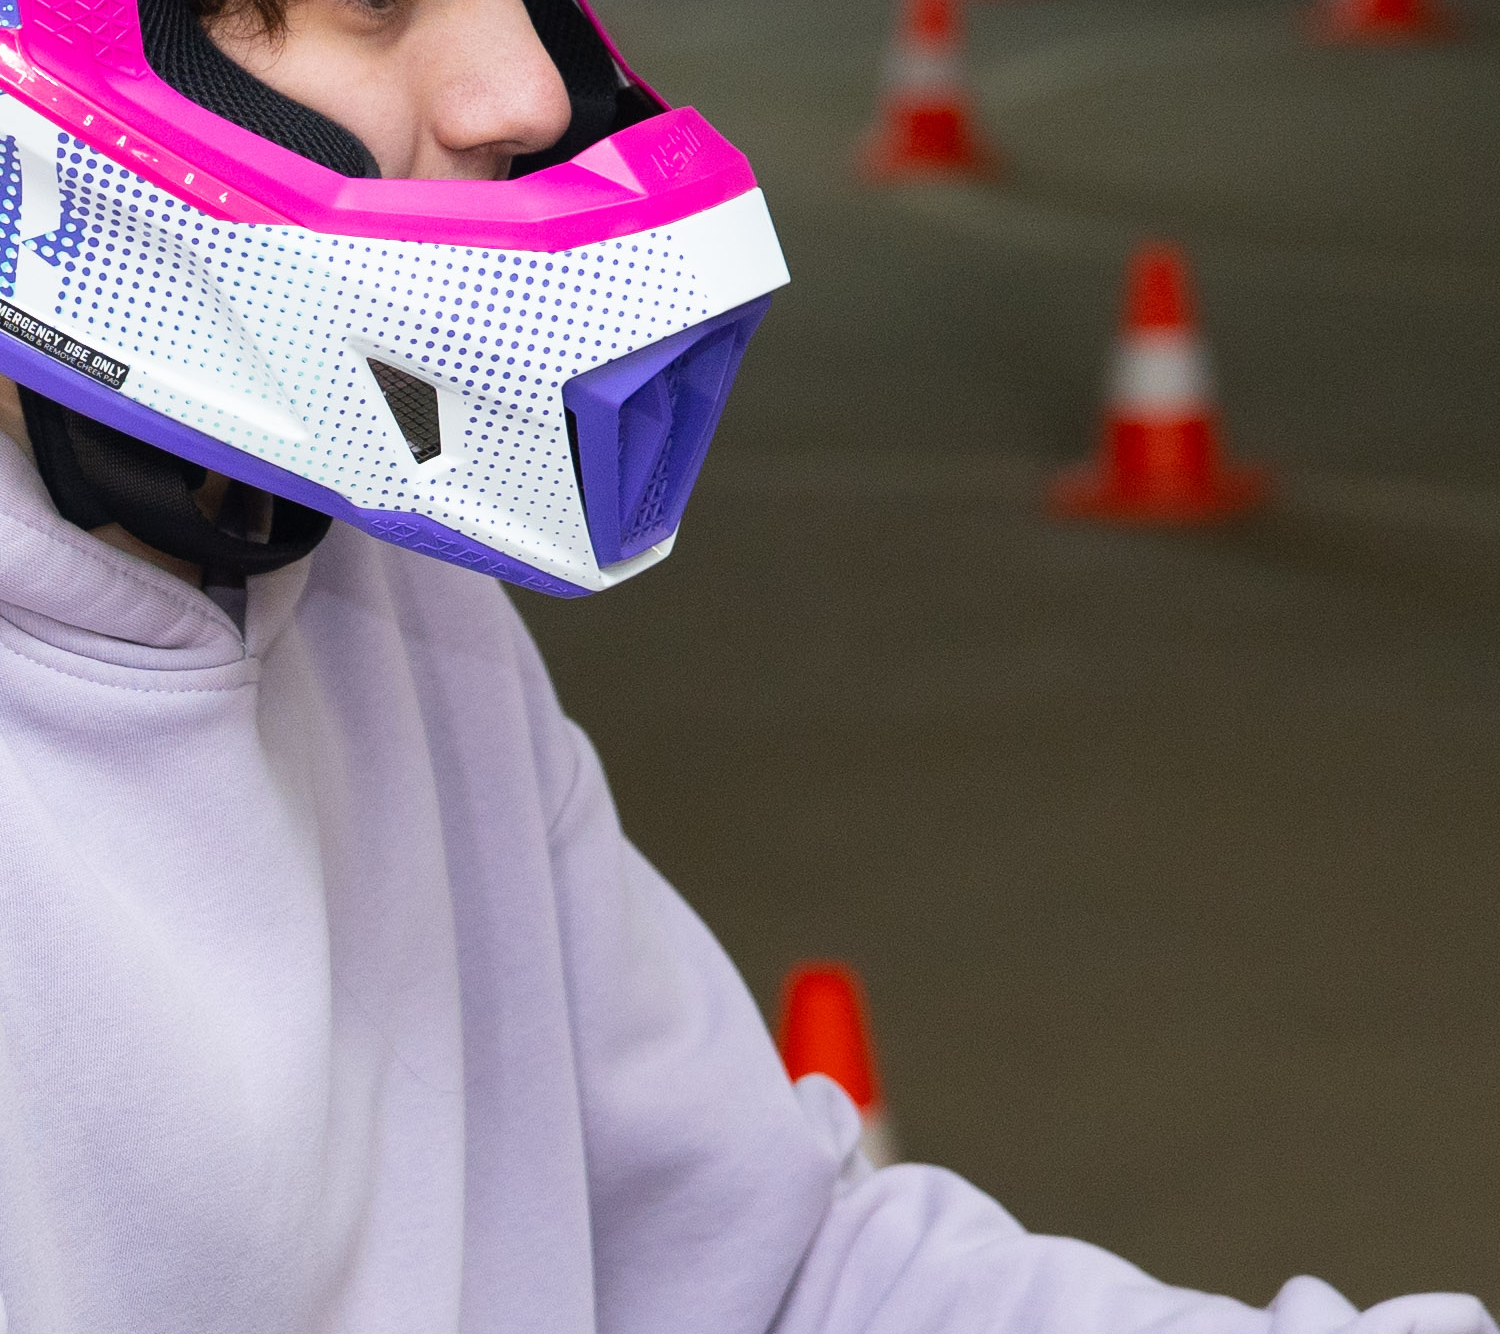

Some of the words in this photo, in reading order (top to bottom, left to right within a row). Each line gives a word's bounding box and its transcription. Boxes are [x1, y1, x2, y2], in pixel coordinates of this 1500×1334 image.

[3, 319, 19, 333] RED
[20, 328, 36, 342] TAB
[35, 337, 43, 346] &
[43, 342, 76, 364] REMOVE
[76, 359, 103, 378] CHEEK
[103, 373, 120, 387] PAD
[64, 340, 91, 363] USE
[92, 354, 126, 378] ONLY
